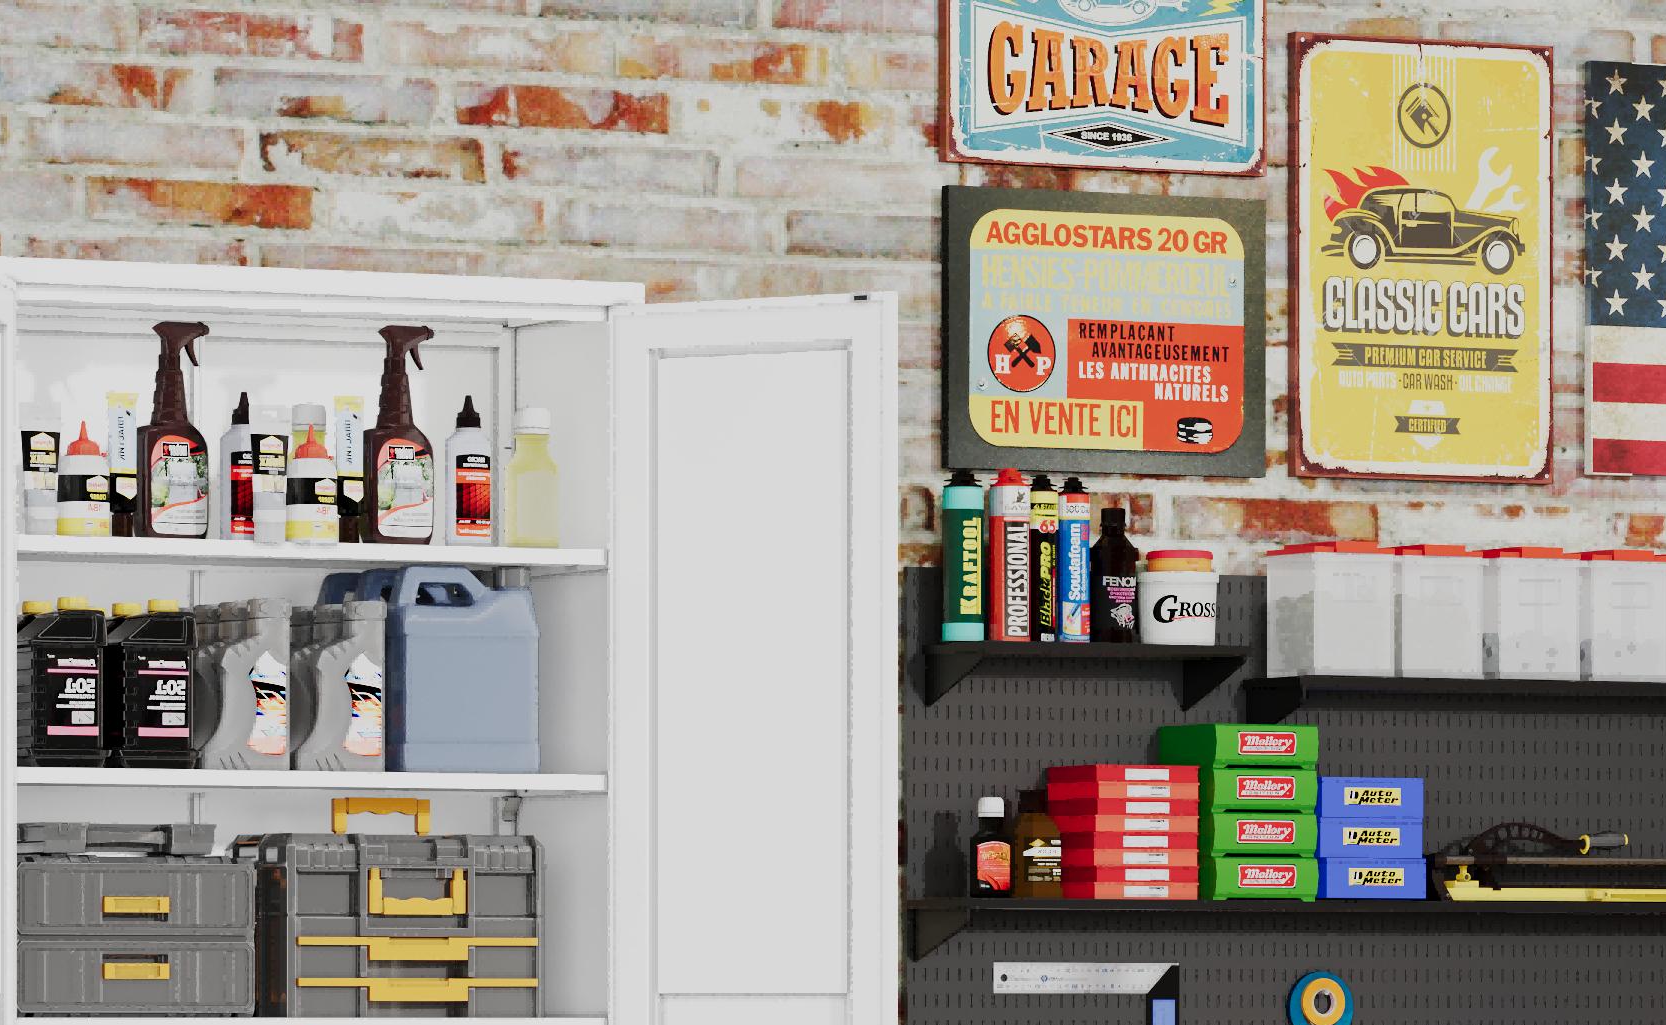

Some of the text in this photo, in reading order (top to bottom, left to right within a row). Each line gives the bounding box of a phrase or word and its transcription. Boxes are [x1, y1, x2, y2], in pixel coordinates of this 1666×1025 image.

[988, 20, 1229, 127] GARAGE
[1081, 131, 1110, 141] SINCE
[986, 221, 1228, 254] AGGLOSTARS 20 GR
[1323, 276, 1525, 339] CLASSIC CARS
[1079, 322, 1175, 342] REMPLAÇANT
[1092, 342, 1229, 362] AVANTAGEUSEMENT
[1364, 347, 1487, 369] PREMIUM CAR SERVICE
[995, 354, 1052, 375] H P
[1078, 361, 1211, 384] LES ANTHRACITES
[1366, 371, 1397, 389] PARTS
[1403, 373, 1422, 390] CAR
[1424, 373, 1453, 391] WASH
[1154, 384, 1229, 402] NATURELS
[991, 401, 1137, 437] EN VENTE ICI
[1408, 418, 1447, 433] CERTIFIED
[1038, 520, 1057, 533] 65
[960, 516, 980, 615] KRAFTOOL
[1068, 523, 1081, 601] Soudafoam
[1008, 523, 1029, 637] PROFESSIONAL
[1153, 595, 1215, 623] GROSS
[1245, 736, 1293, 749] Mallory
[1243, 779, 1292, 793] Mallory
[1243, 824, 1292, 838] Mallory
[1357, 837, 1397, 845] Meter
[1245, 868, 1293, 882] Mallory
[1362, 877, 1401, 885] Meter
